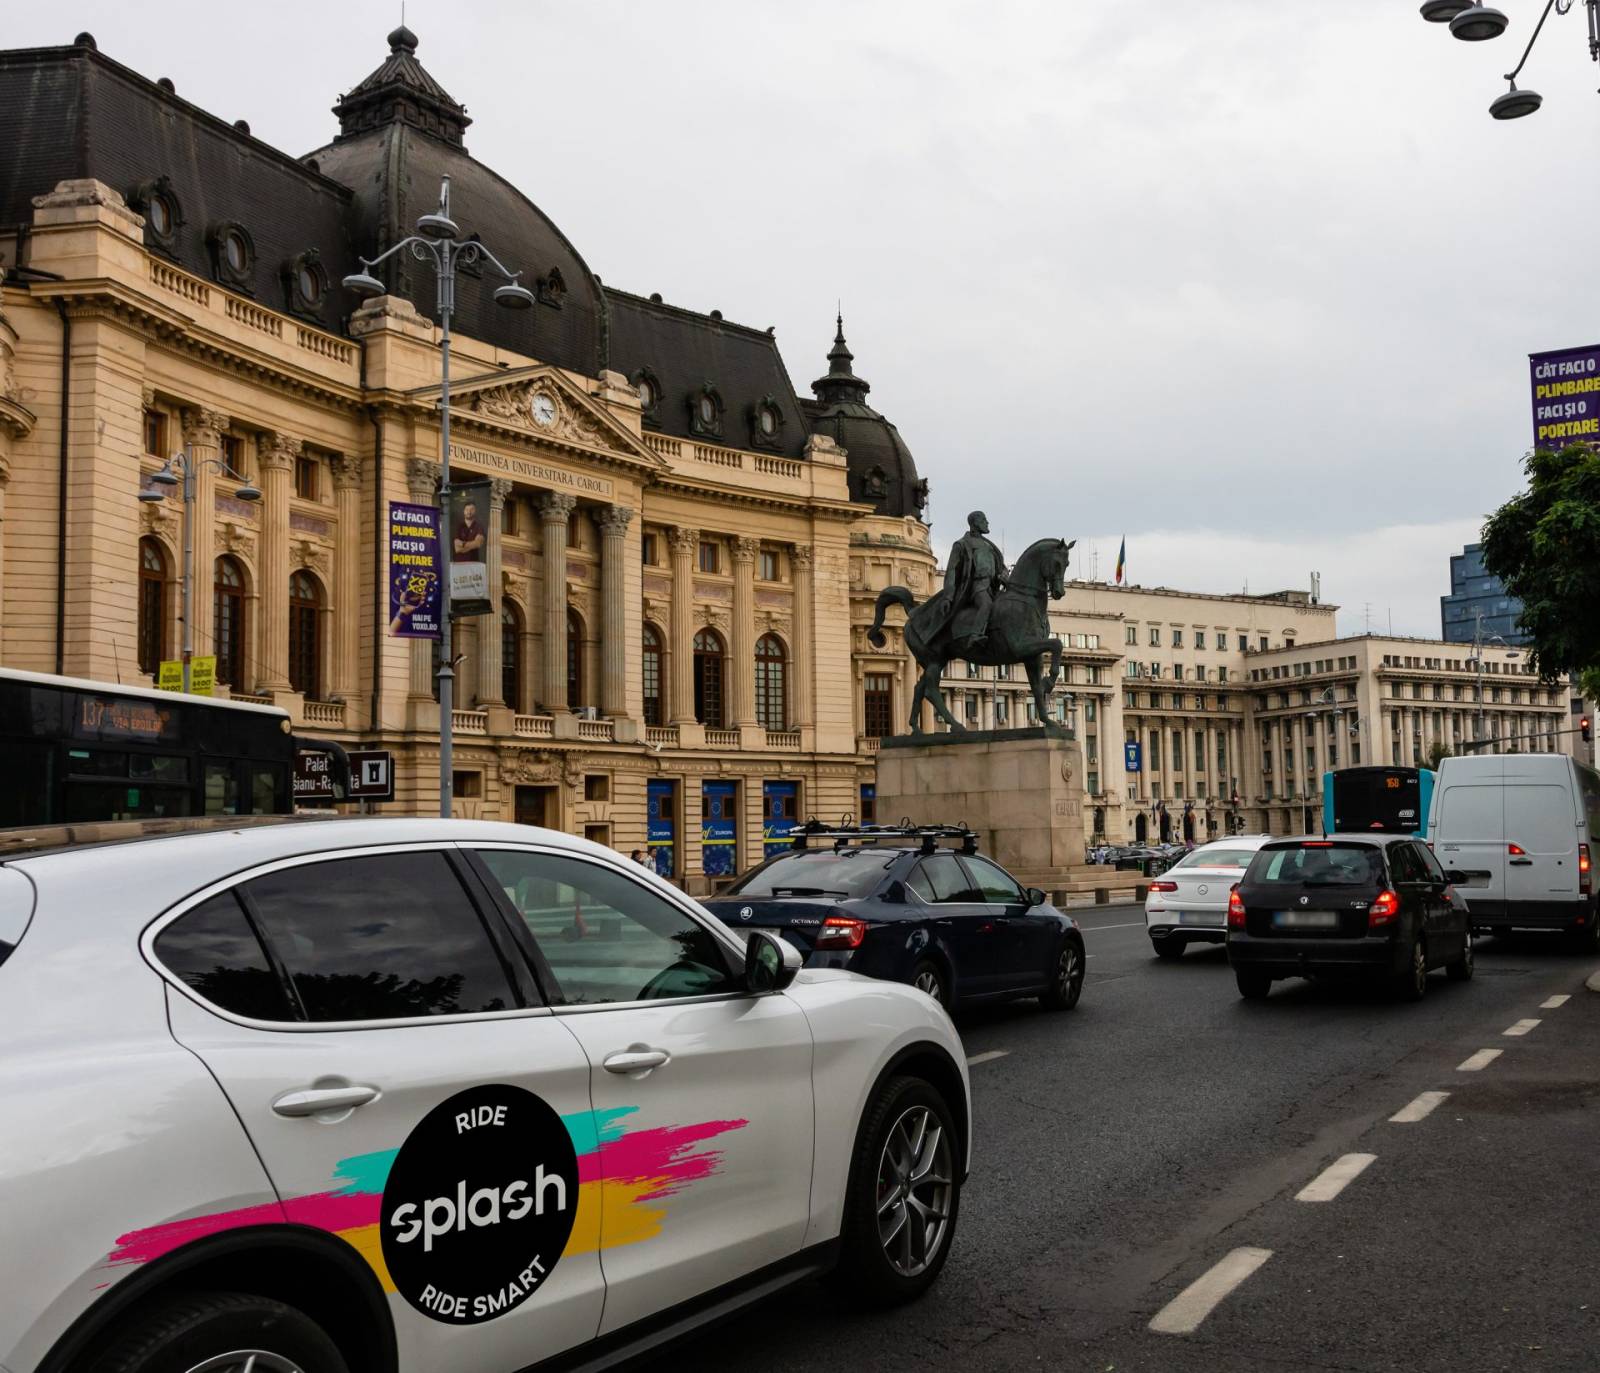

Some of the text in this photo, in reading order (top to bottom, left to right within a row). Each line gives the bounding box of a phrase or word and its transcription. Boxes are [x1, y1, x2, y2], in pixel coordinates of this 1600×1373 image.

[1535, 358, 1596, 379] CÂT FACI O
[1537, 404, 1563, 420] FACI
[1577, 400, 1587, 414] O
[1538, 418, 1599, 440] PORTARE
[576, 476, 604, 493] CAROL
[392, 509, 431, 524] CÂT FACI O
[392, 540, 410, 551] FACI
[418, 542, 425, 552] O
[392, 553, 433, 566] PORTARE
[412, 614, 432, 622] HAI PE
[81, 700, 105, 727] 137
[455, 1105, 508, 1135] RIDE
[390, 1163, 567, 1252] splash
[419, 1254, 546, 1318] RIDE SMART
